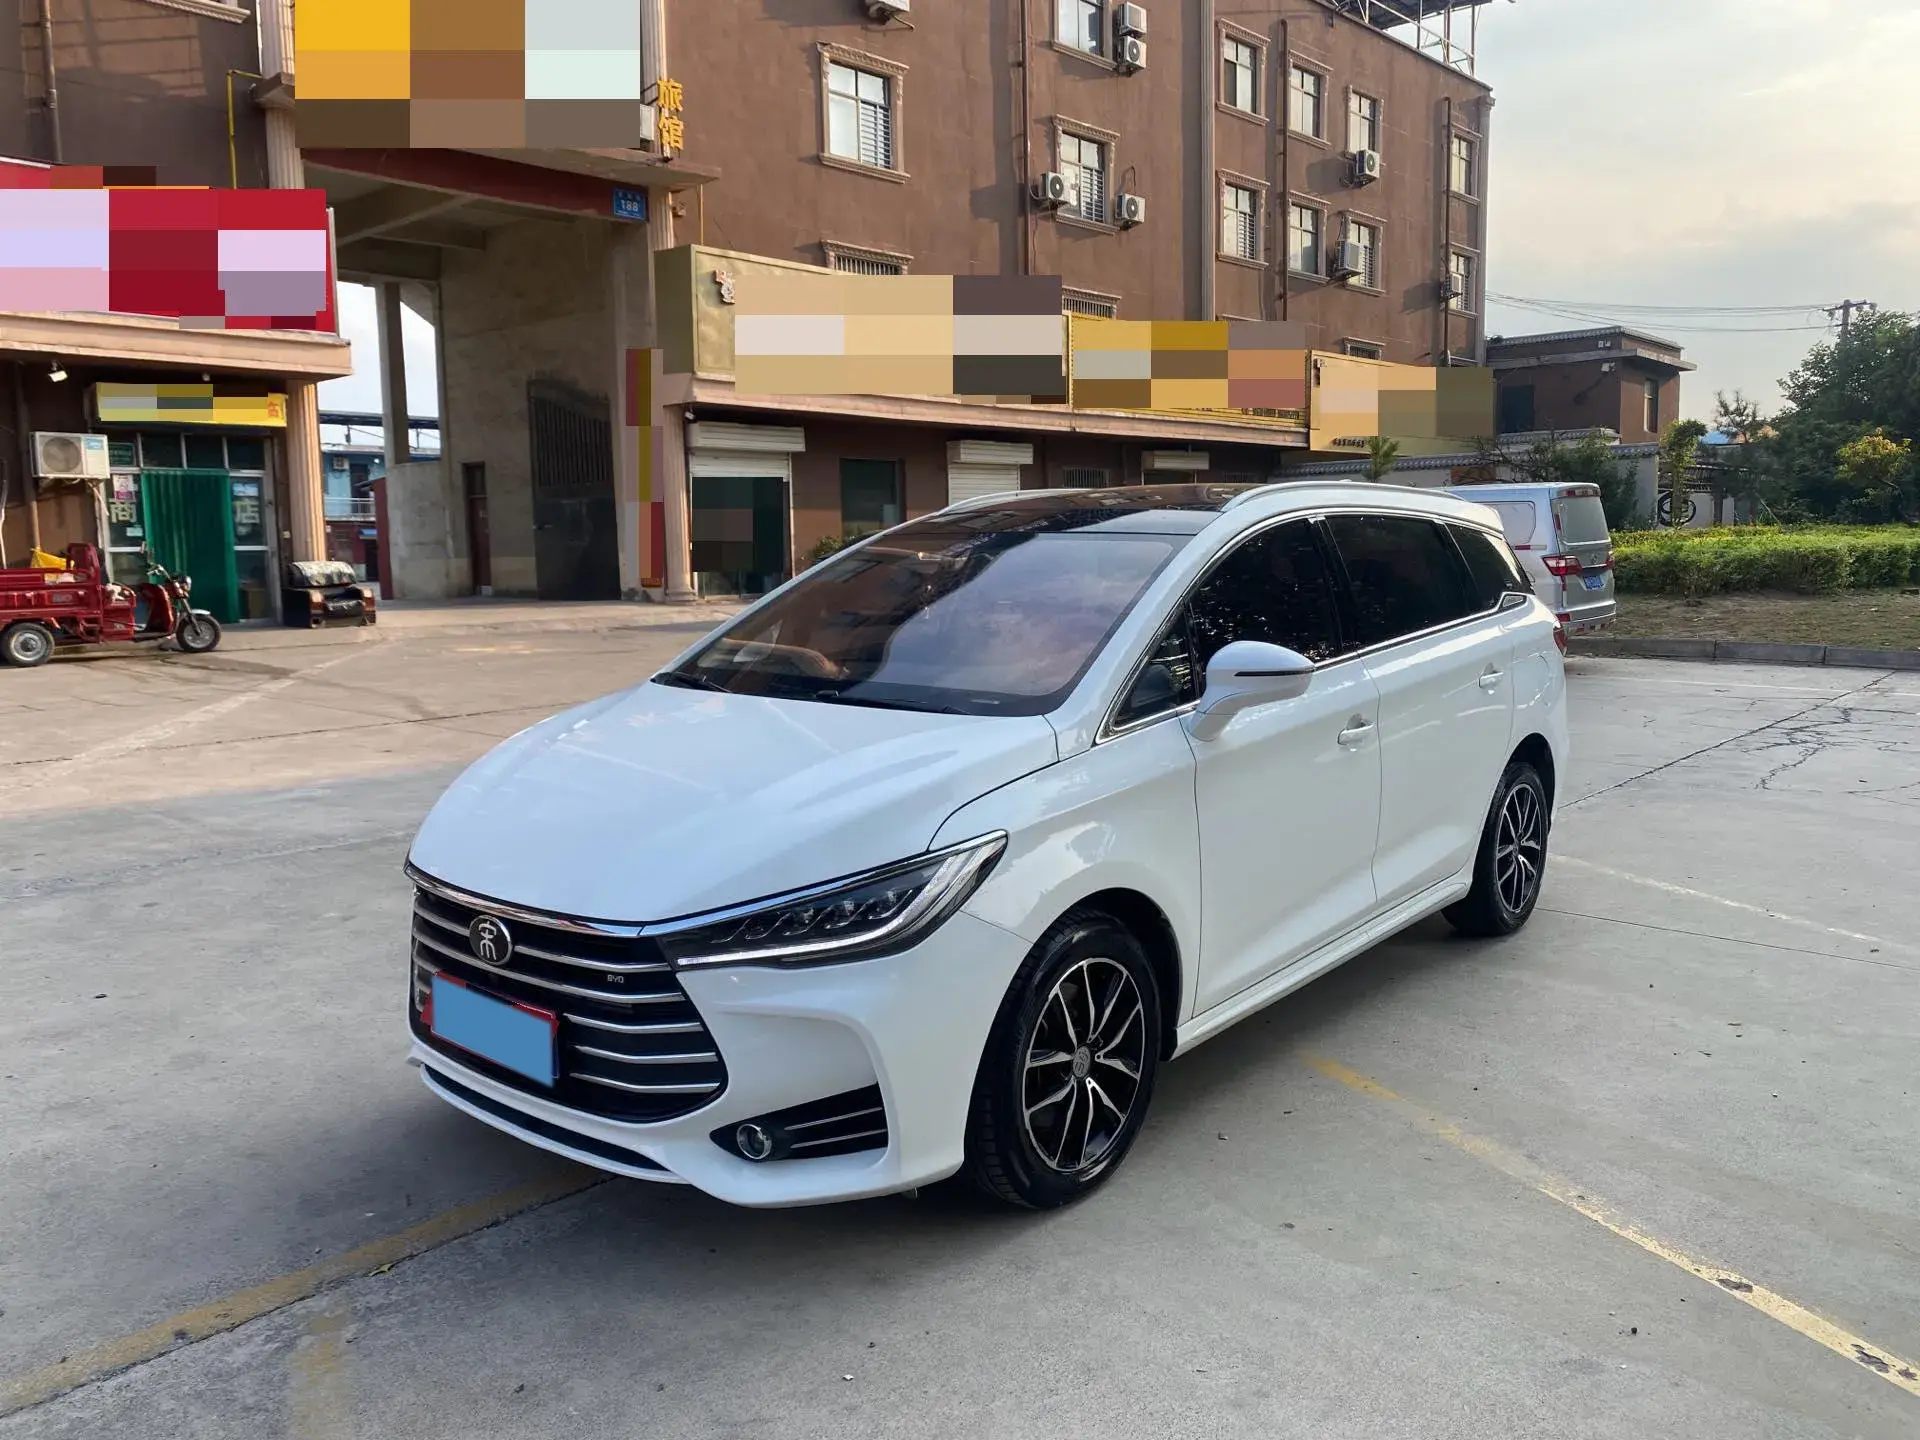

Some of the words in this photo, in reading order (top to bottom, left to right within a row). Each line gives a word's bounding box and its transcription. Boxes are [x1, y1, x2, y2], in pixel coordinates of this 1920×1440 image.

[657, 78, 684, 150] 旅馆
[620, 199, 639, 212] 188
[108, 497, 137, 523] 商
[233, 497, 260, 524] 店
[607, 974, 624, 984] BYD
